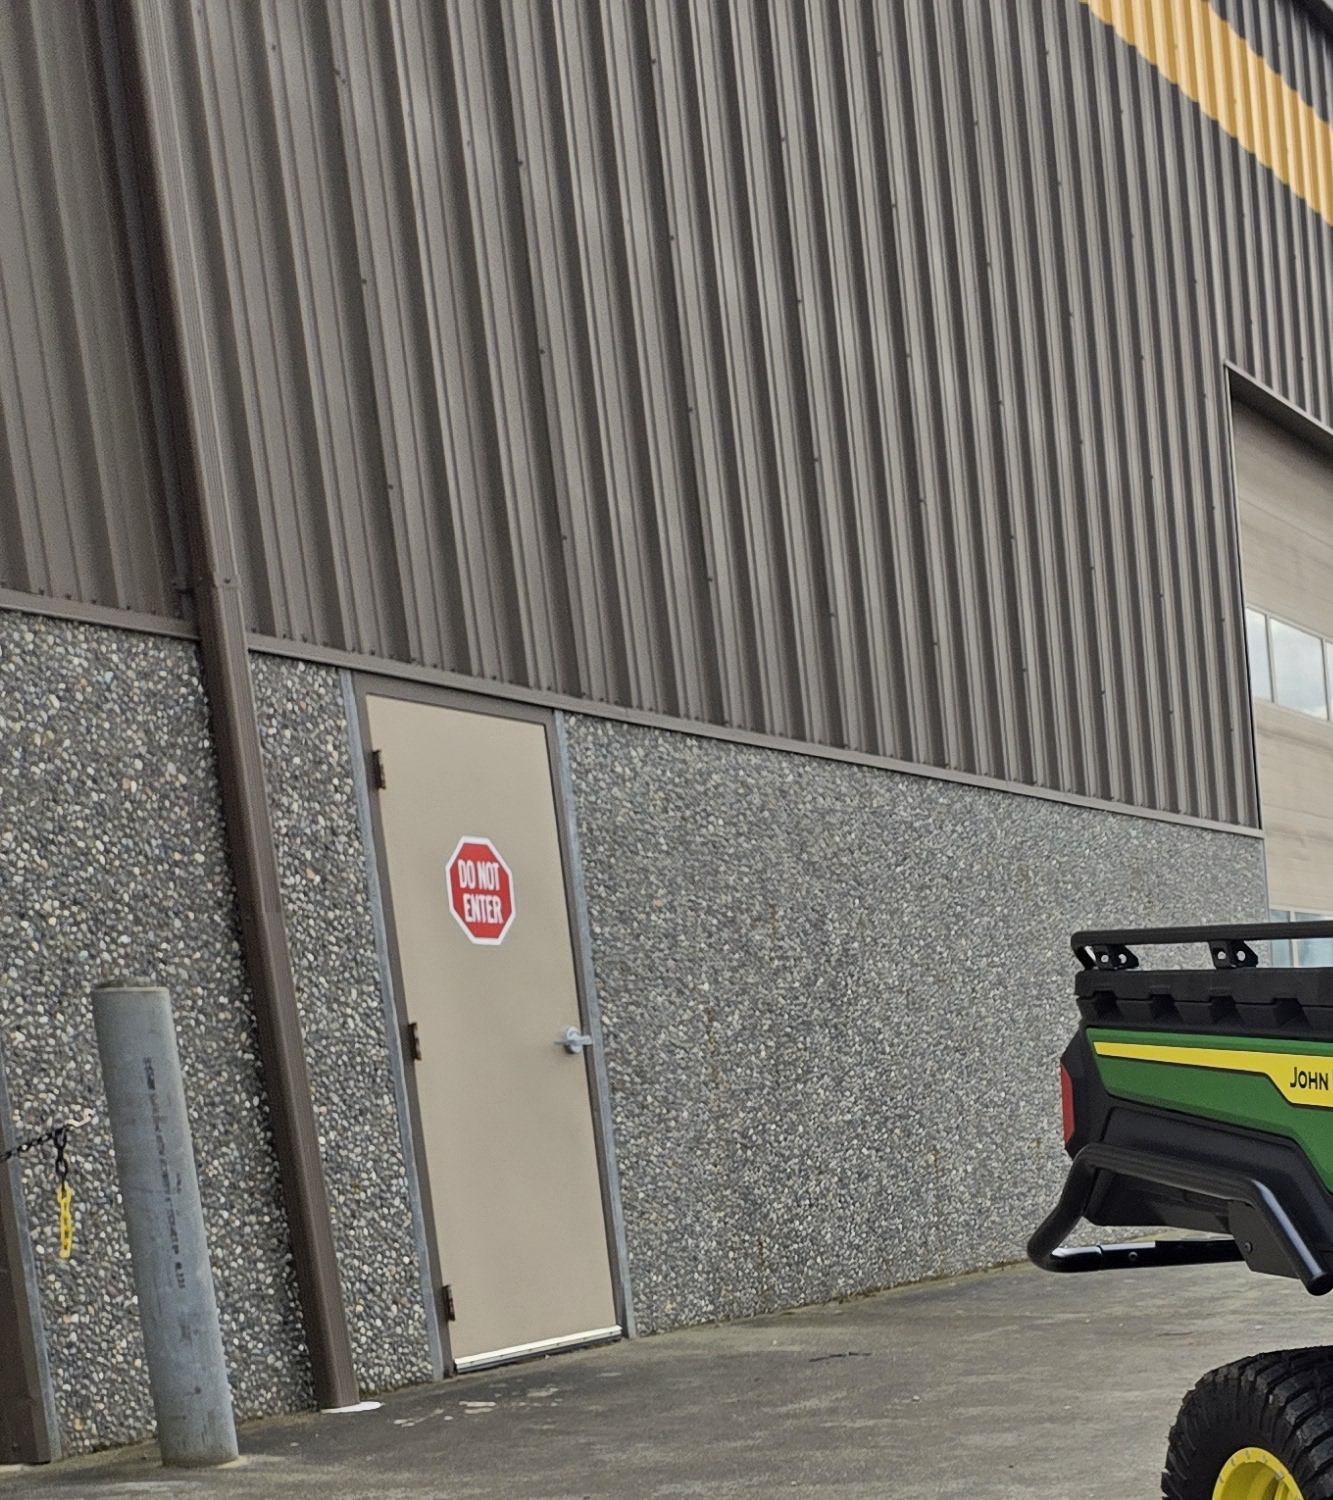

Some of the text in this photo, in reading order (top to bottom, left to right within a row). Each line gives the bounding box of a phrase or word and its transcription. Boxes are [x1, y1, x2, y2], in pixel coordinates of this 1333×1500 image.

[458, 859, 501, 891] DO NOT
[463, 893, 504, 924] ENTER
[1290, 1066, 1329, 1091] JOHN
